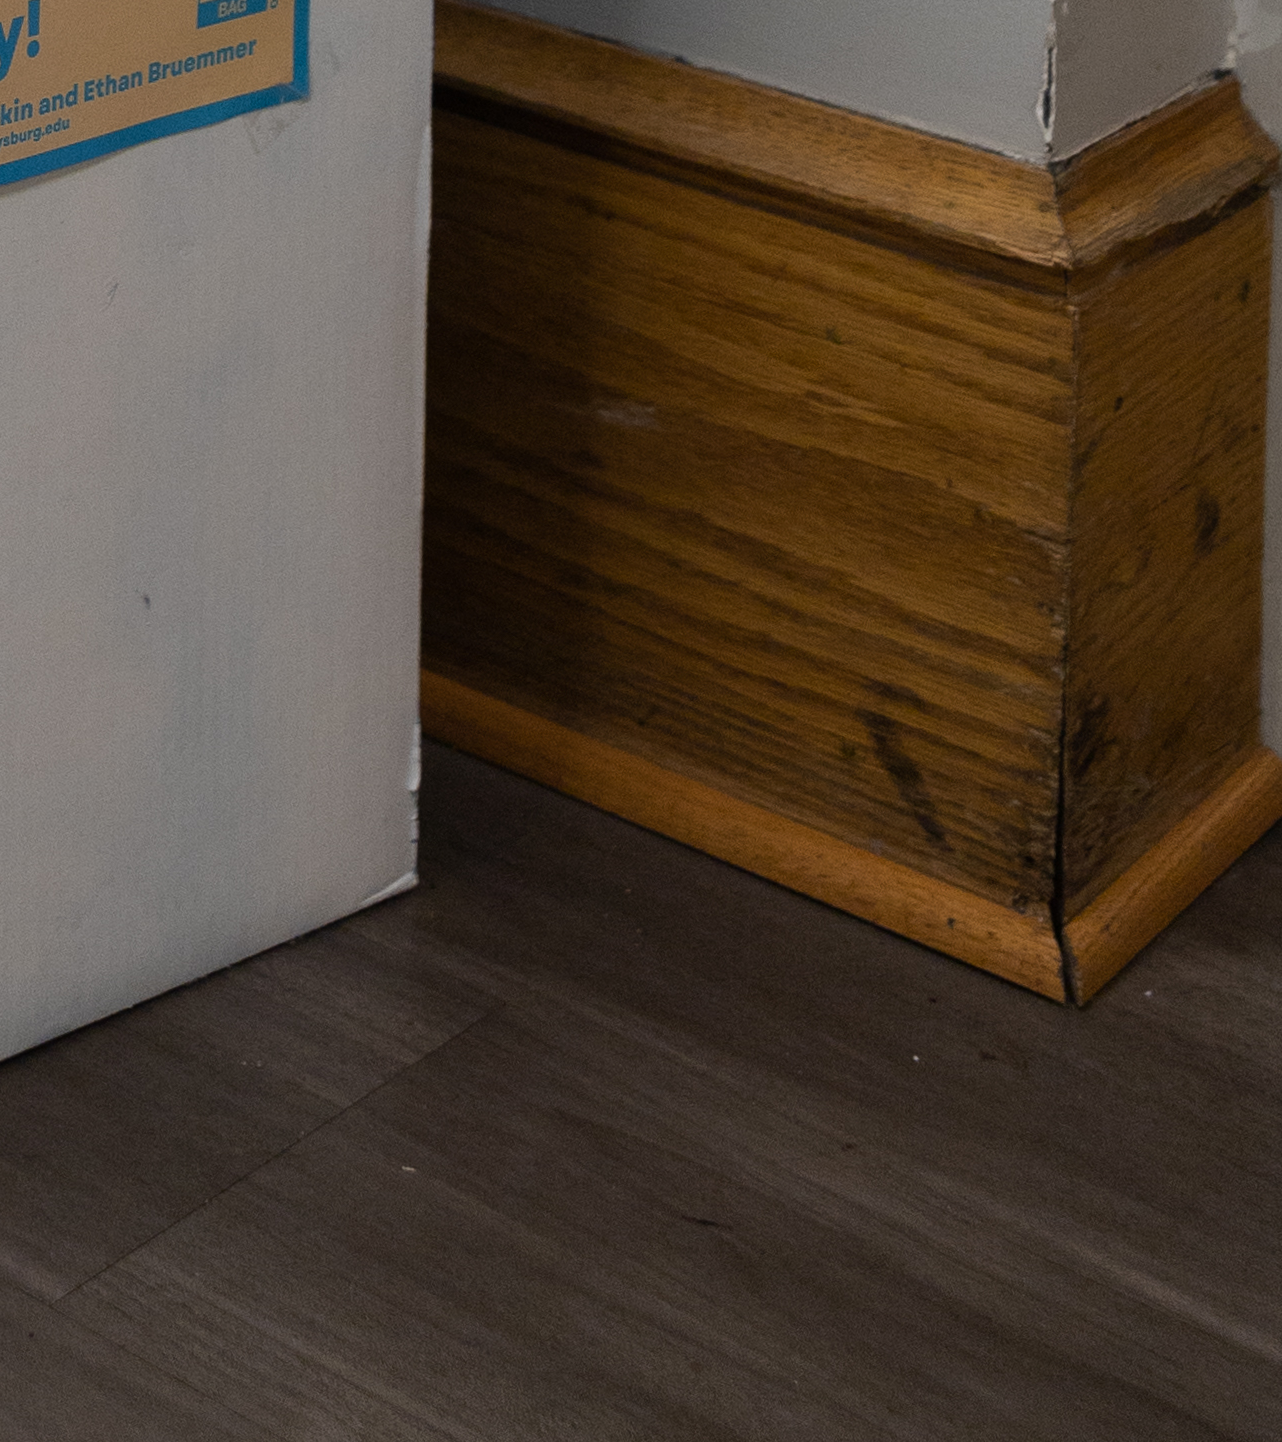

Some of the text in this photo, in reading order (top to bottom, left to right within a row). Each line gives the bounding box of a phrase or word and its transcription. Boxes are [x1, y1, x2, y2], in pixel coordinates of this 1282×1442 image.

[39, 84, 79, 115] and
[84, 71, 143, 102] Ethan
[147, 40, 257, 83] Bruemmer
